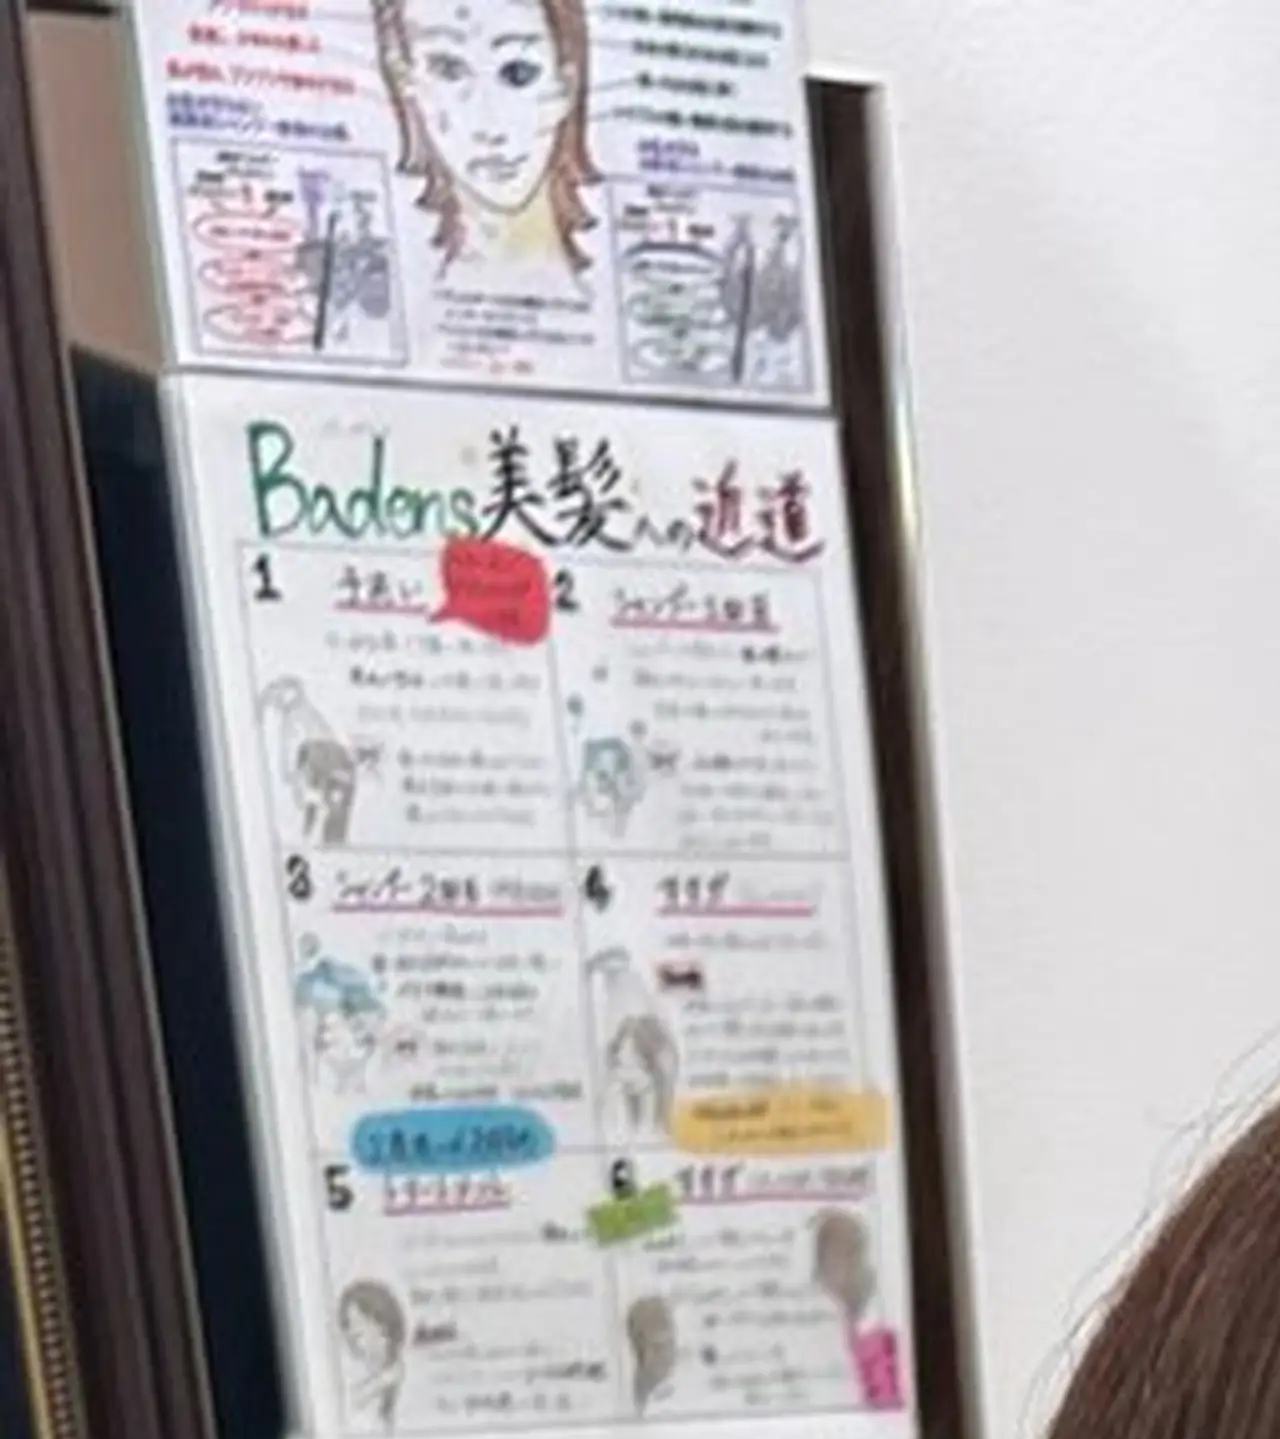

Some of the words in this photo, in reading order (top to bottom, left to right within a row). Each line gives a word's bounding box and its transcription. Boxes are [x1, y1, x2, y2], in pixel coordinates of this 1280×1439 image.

[253, 553, 282, 602] 1
[554, 570, 581, 613] 2
[286, 854, 312, 901] 3
[324, 1164, 354, 1211] 5
